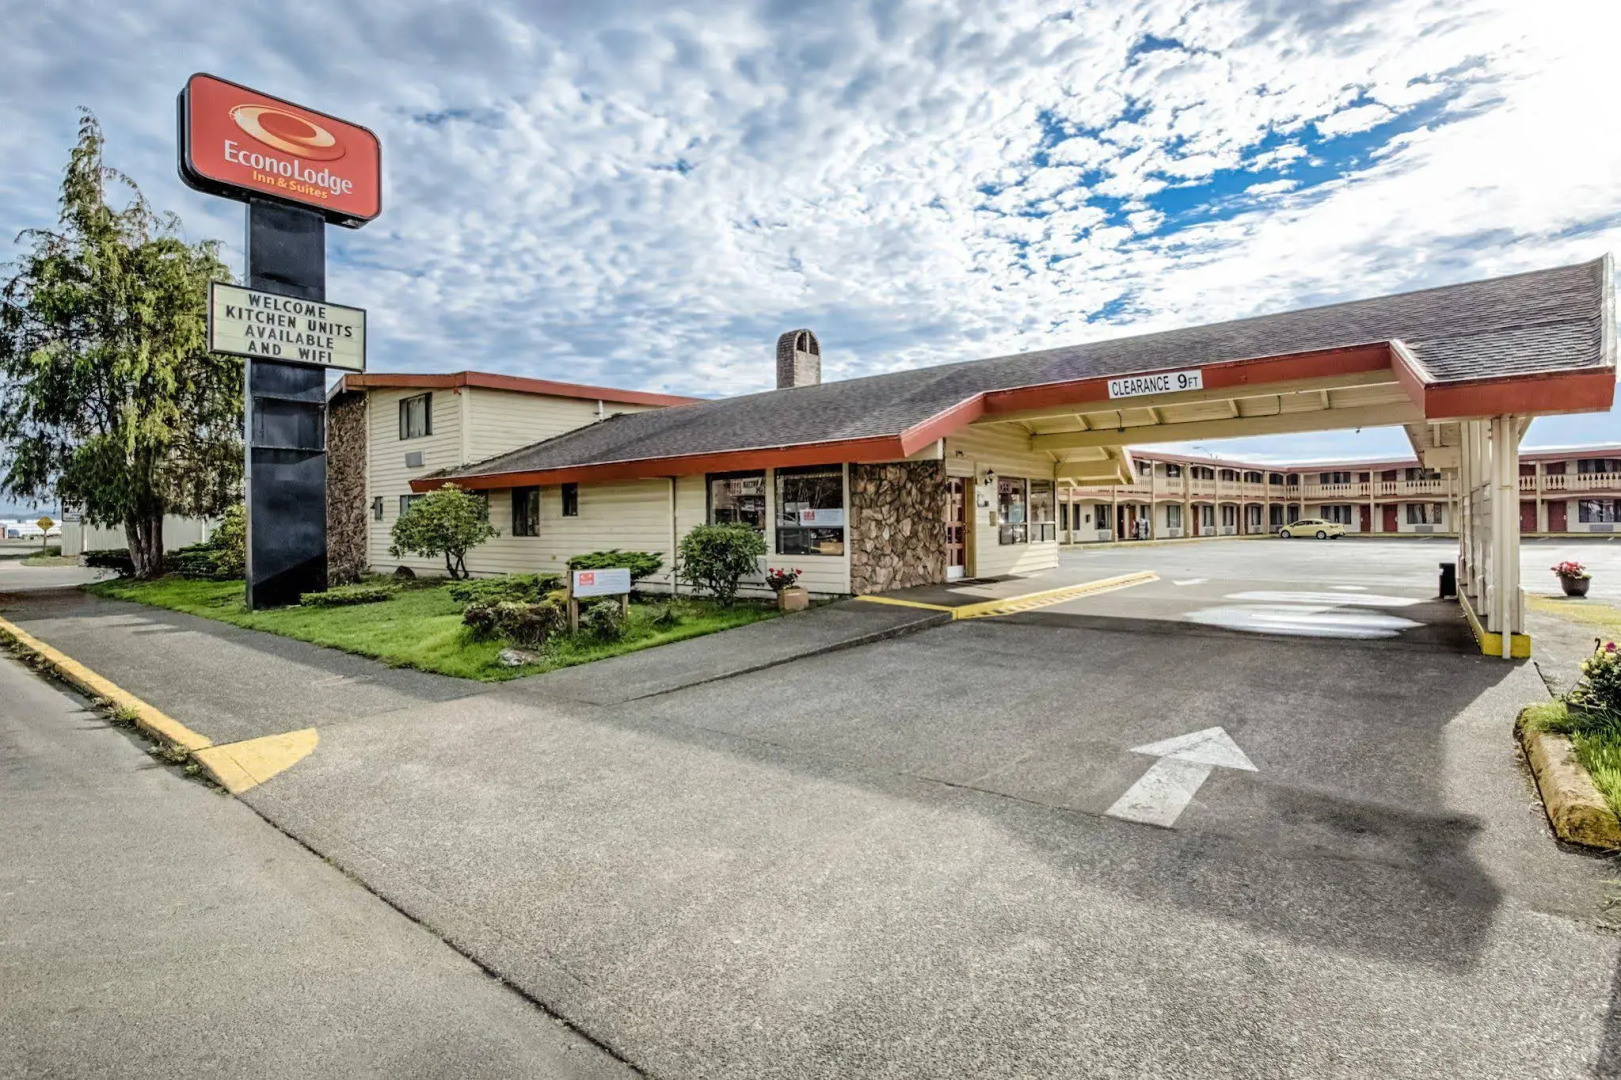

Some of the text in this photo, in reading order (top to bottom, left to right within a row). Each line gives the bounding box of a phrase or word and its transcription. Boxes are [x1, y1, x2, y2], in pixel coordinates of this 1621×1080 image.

[253, 170, 328, 199] Inn & Suites
[248, 293, 326, 319] WELCOME
[226, 305, 353, 337] KITCHEN UNITS
[245, 324, 334, 350] AVAILABLE
[248, 340, 332, 363] AND WIFI
[1111, 375, 1170, 396] CLEARANCE
